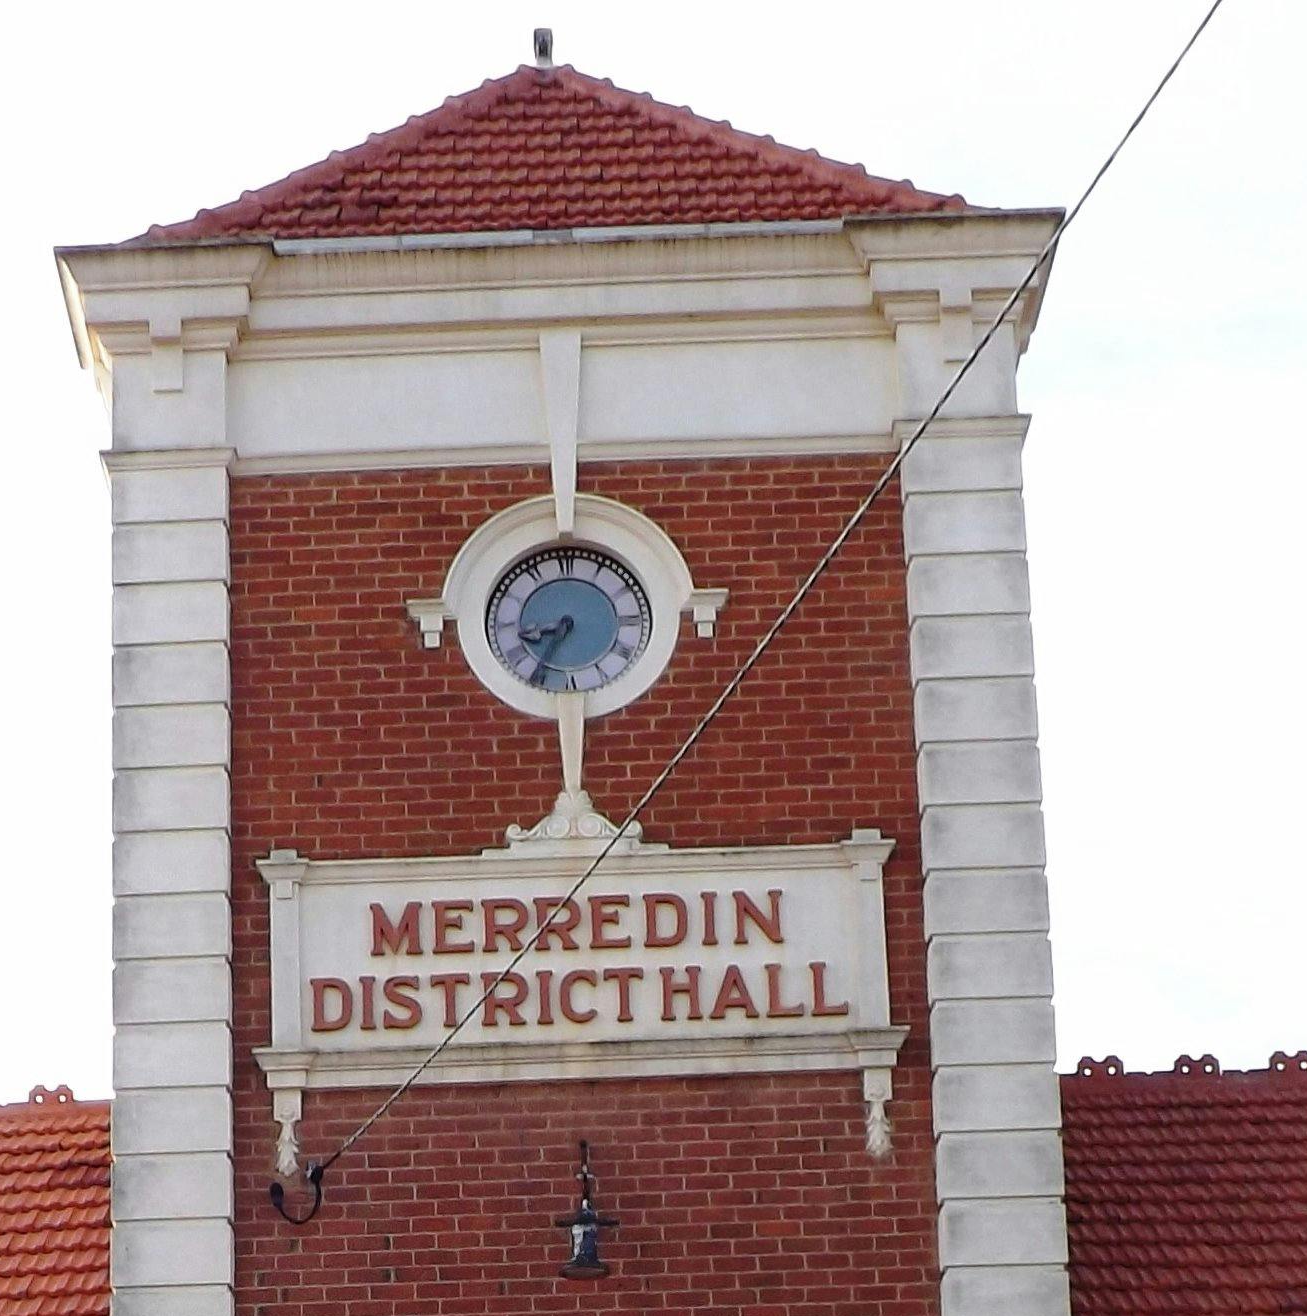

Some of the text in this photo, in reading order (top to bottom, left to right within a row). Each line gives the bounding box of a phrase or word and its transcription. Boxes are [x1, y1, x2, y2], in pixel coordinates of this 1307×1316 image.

[369, 889, 785, 956] MERREDIN
[309, 961, 850, 1032] DISTRICT HALL
